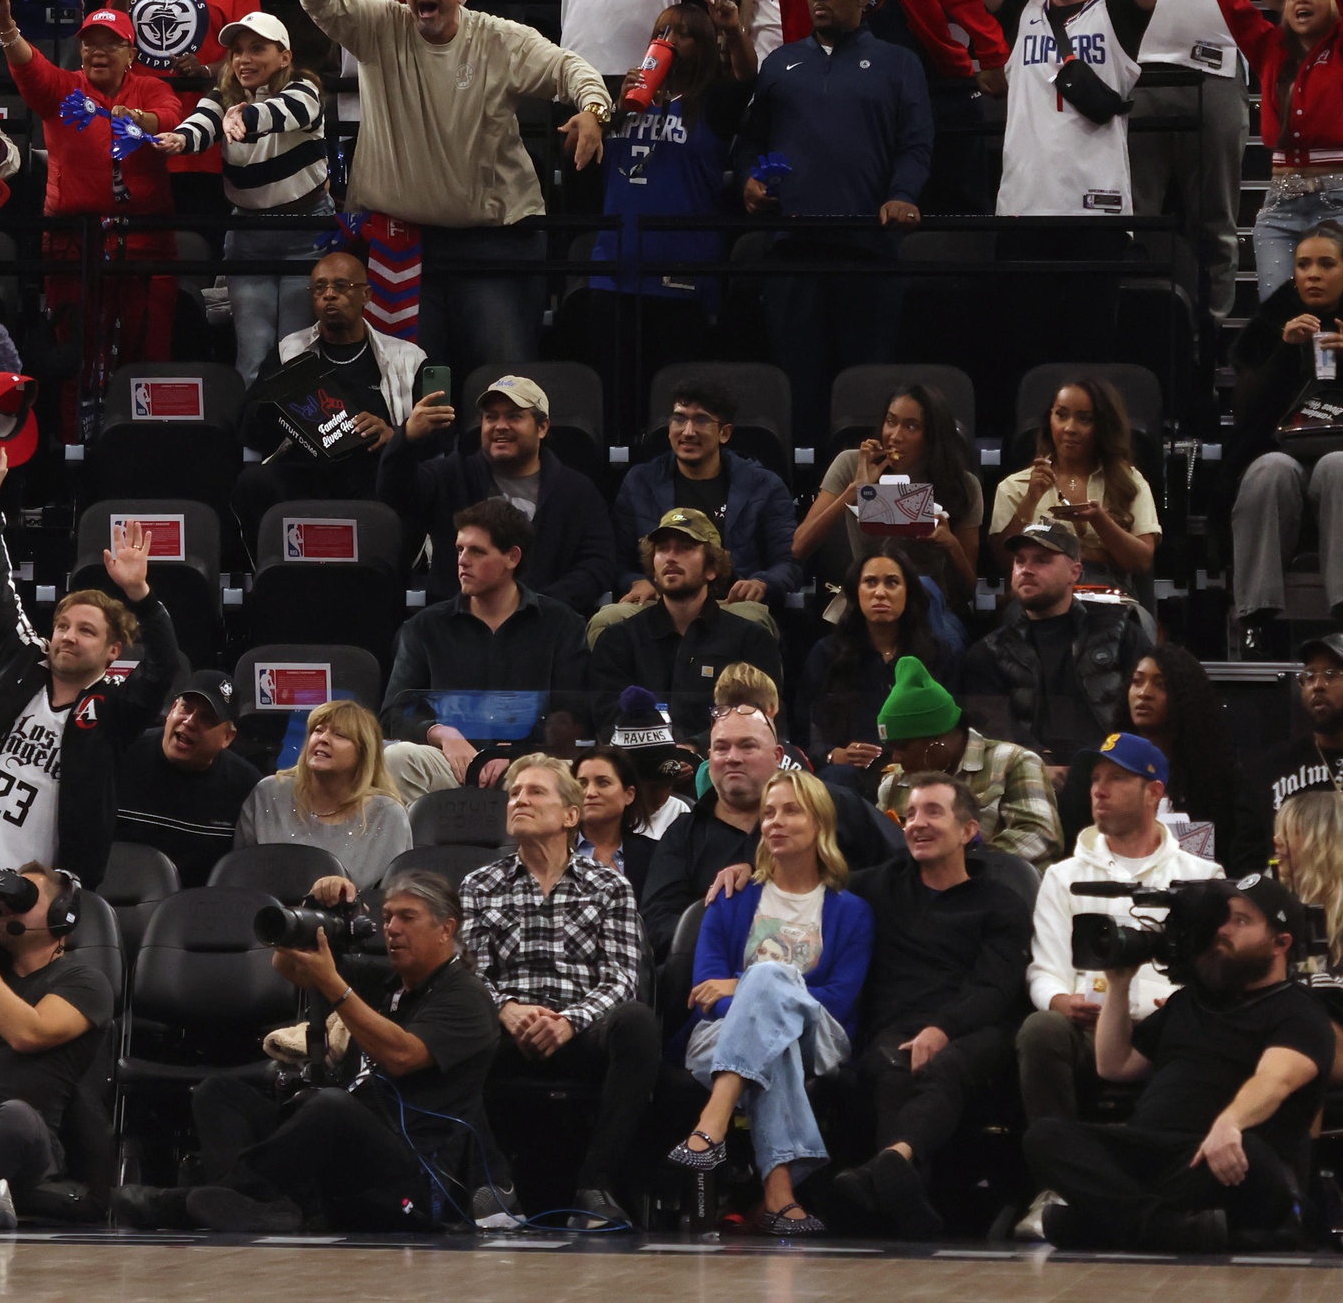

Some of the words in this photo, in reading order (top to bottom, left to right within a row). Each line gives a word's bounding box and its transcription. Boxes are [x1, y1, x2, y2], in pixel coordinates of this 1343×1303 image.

[317, 409, 349, 436] Fandom
[277, 416, 300, 440] INTUIT
[297, 436, 319, 458] DOME
[322, 429, 344, 449] Lives
[17, 715, 60, 745] Los
[623, 730, 668, 745] RAVENS
